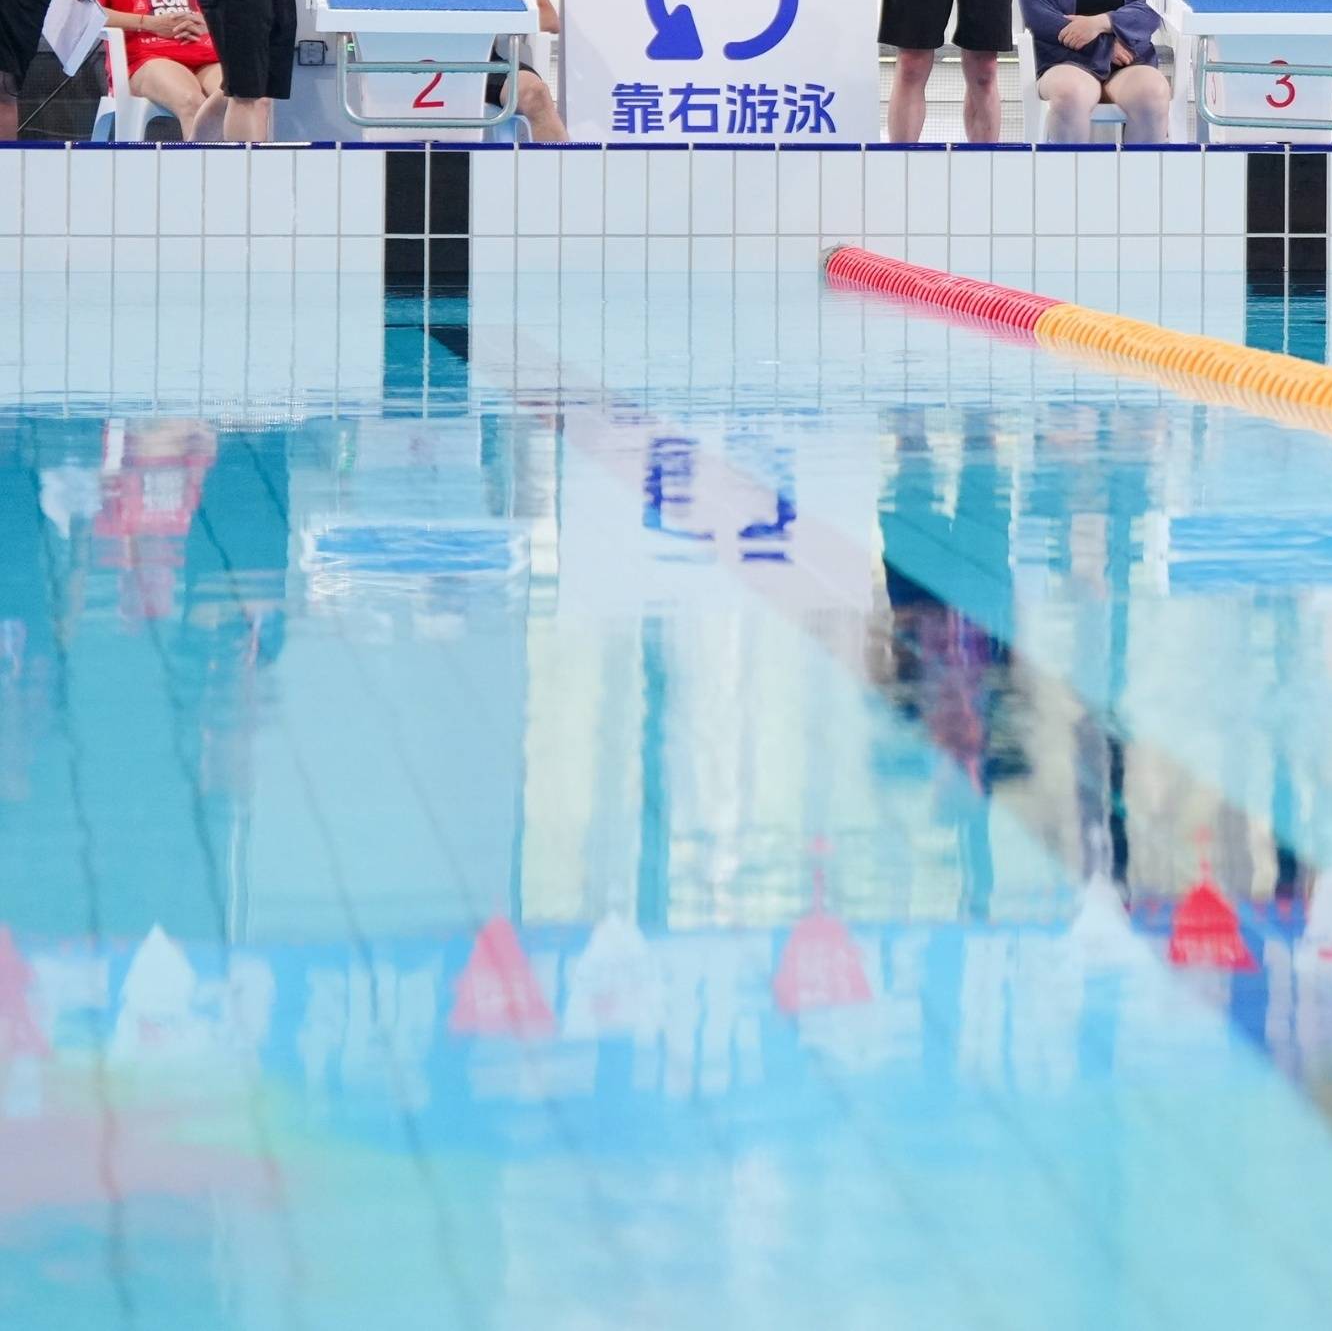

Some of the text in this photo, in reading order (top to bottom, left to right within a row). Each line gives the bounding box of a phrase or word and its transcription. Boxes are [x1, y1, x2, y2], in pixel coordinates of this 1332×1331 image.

[412, 59, 444, 109] 2
[611, 82, 837, 134] 靠右游泳
[1265, 59, 1295, 109] 3
